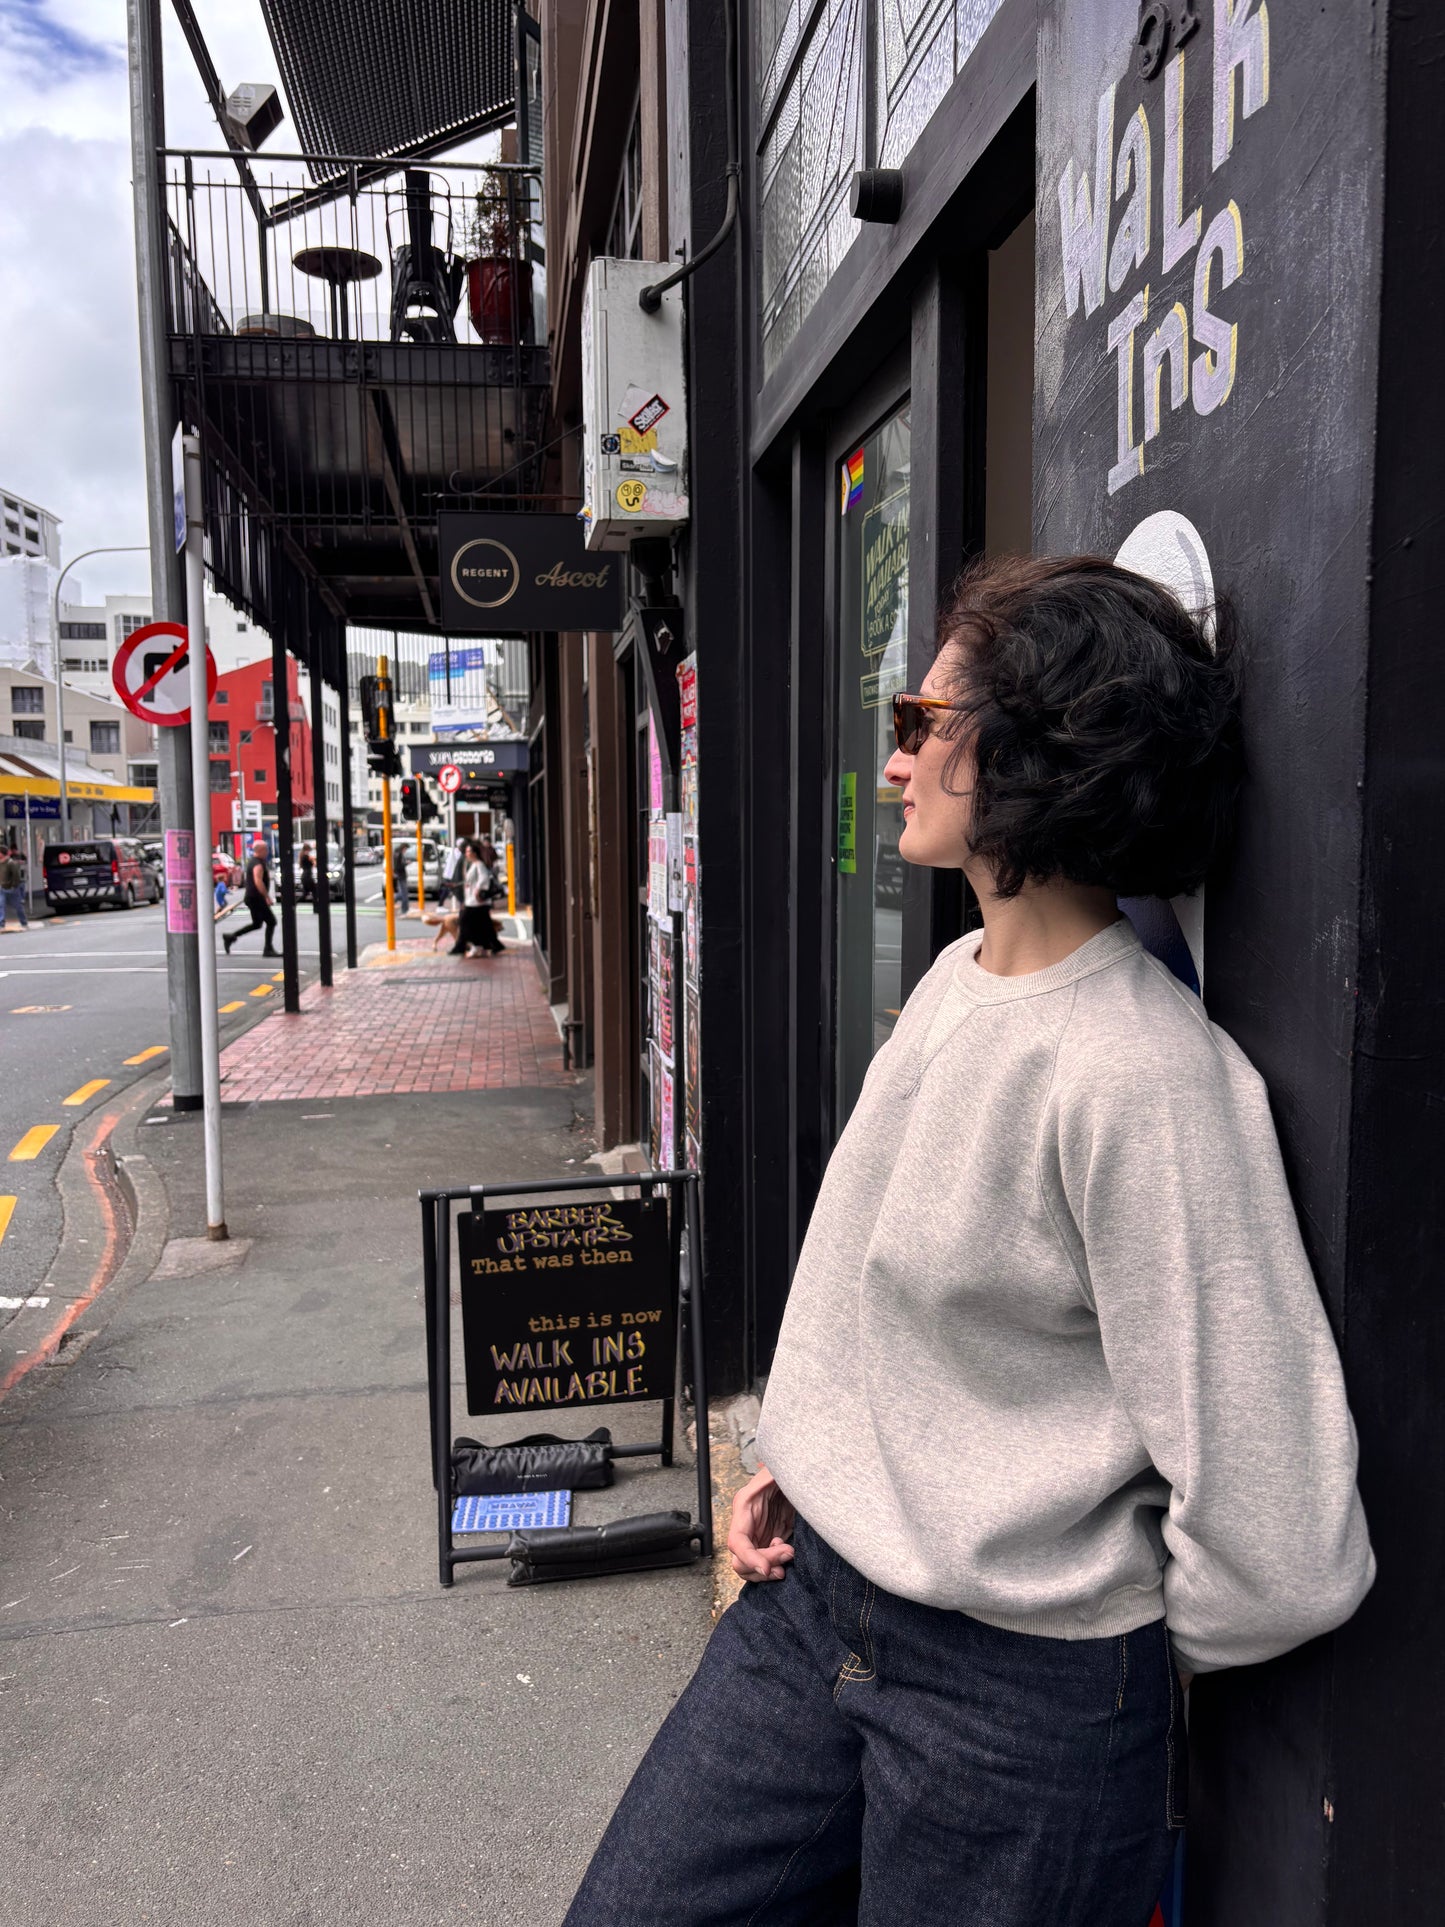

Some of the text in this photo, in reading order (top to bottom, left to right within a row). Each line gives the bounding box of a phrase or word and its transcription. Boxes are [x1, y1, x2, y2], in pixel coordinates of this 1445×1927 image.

[462, 568, 509, 578] REGENT
[535, 561, 611, 588] Ascot
[866, 538, 910, 614] AVAILABL
[506, 1203, 624, 1230] BARBER
[497, 1224, 633, 1253] UPSTAIRS
[471, 1248, 633, 1275] That was then
[528, 1309, 663, 1333] this is now
[490, 1330, 646, 1372] WALK INS
[493, 1364, 649, 1405] AVAILABLE
